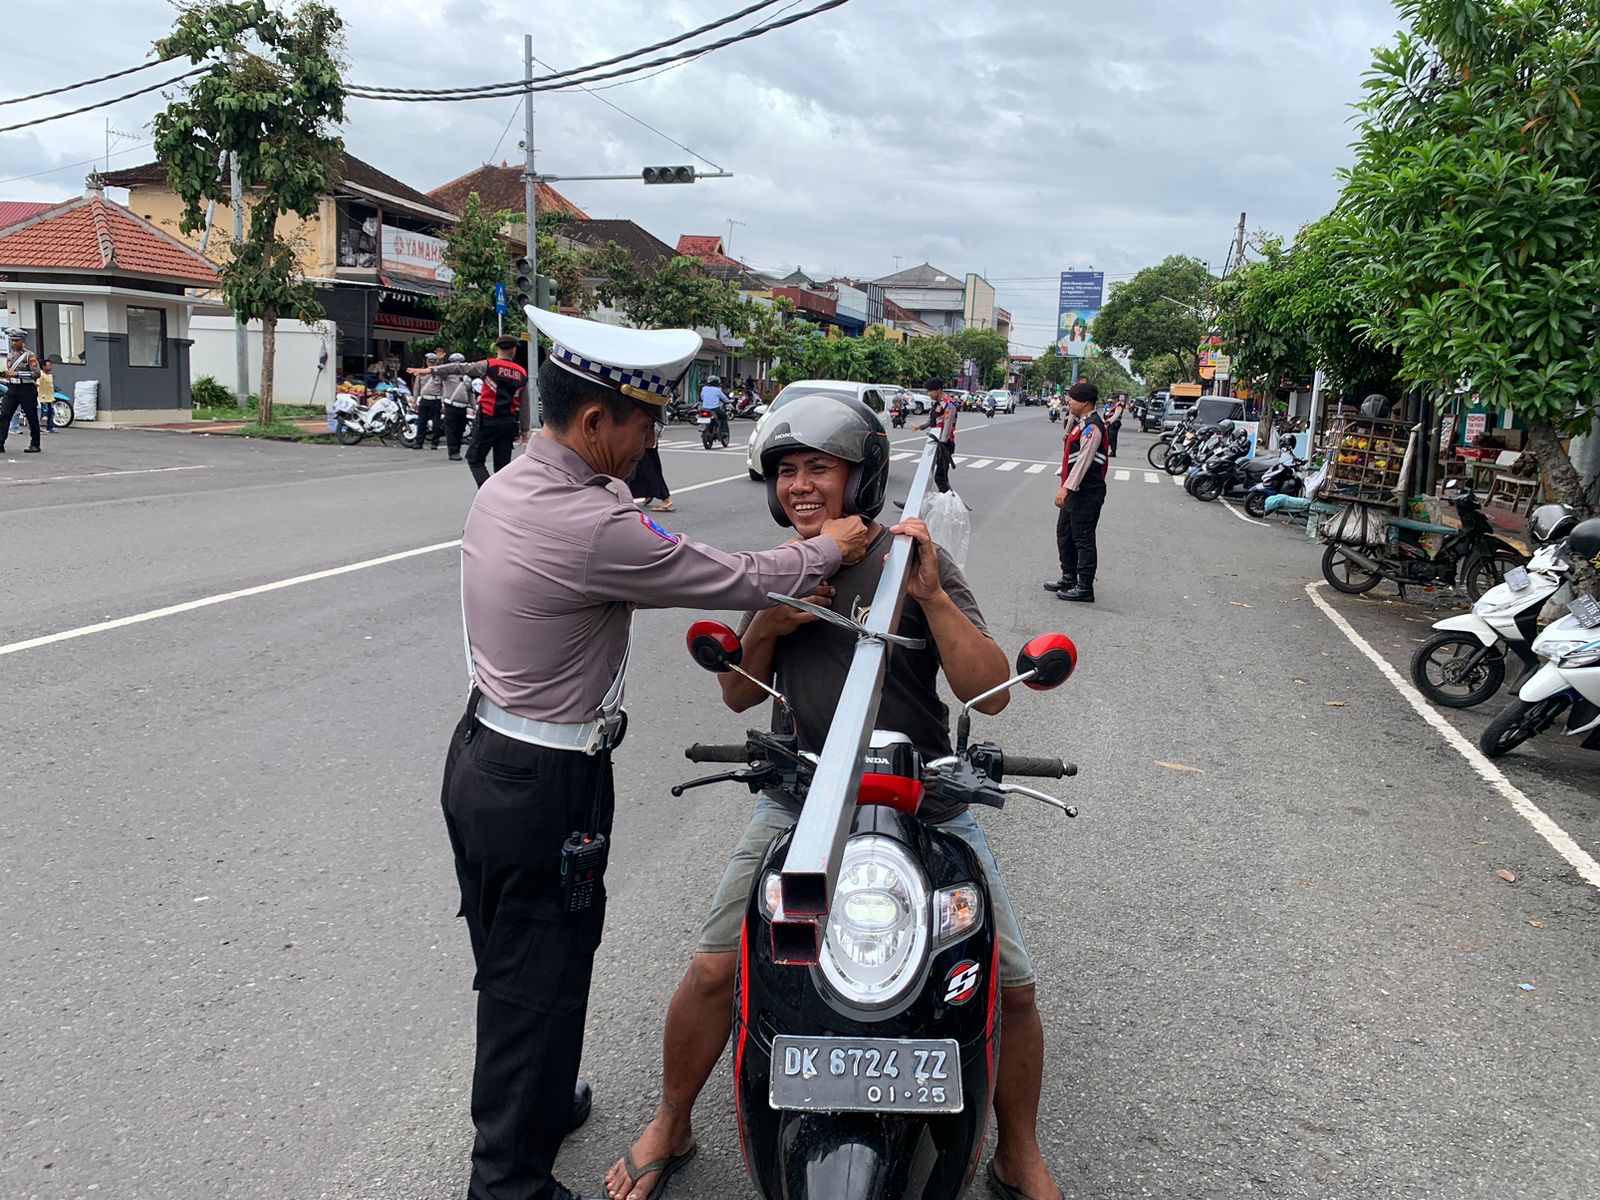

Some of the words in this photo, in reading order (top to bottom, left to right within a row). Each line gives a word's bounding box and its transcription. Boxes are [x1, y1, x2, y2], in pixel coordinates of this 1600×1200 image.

[405, 238, 445, 263] YAMAHA
[498, 367, 522, 382] POLISI
[865, 755, 890, 765] NDA
[784, 1046, 819, 1077] DK
[830, 1047, 899, 1078] 6724
[913, 1050, 948, 1080] ZZ
